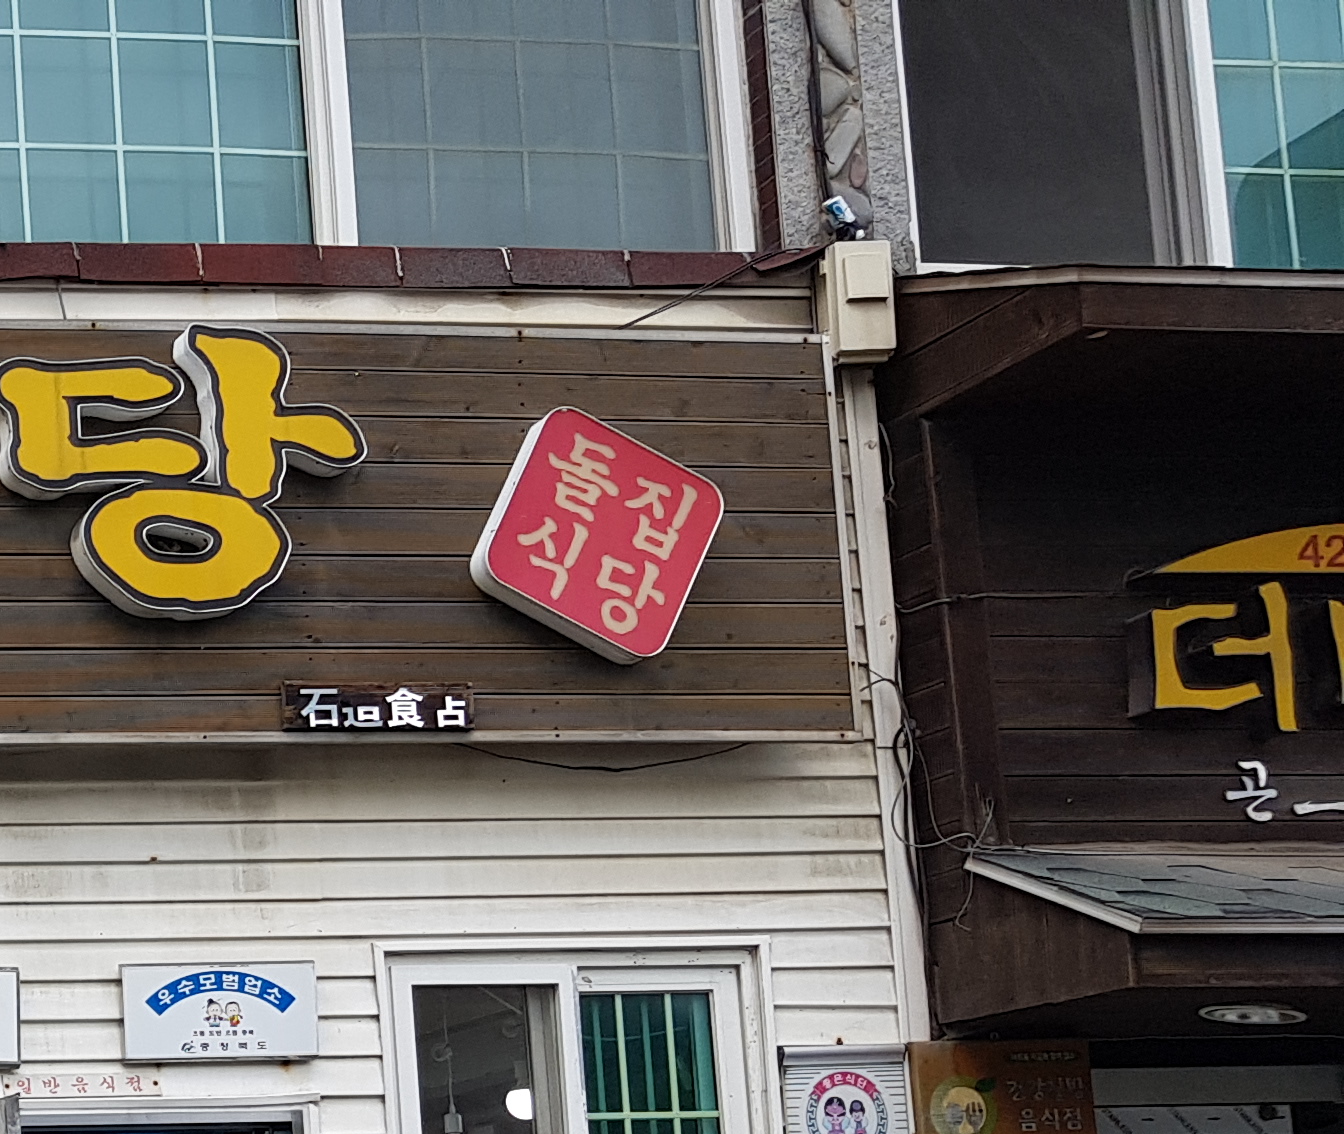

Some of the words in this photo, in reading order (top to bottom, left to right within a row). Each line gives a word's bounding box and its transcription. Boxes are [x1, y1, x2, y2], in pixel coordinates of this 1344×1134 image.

[549, 433, 698, 560] 돌집
[517, 517, 665, 635] 식당
[157, 973, 284, 1006] 우수모범업소
[15, 1074, 144, 1095] 일반음식점
[1019, 1107, 1083, 1132] 음식점
